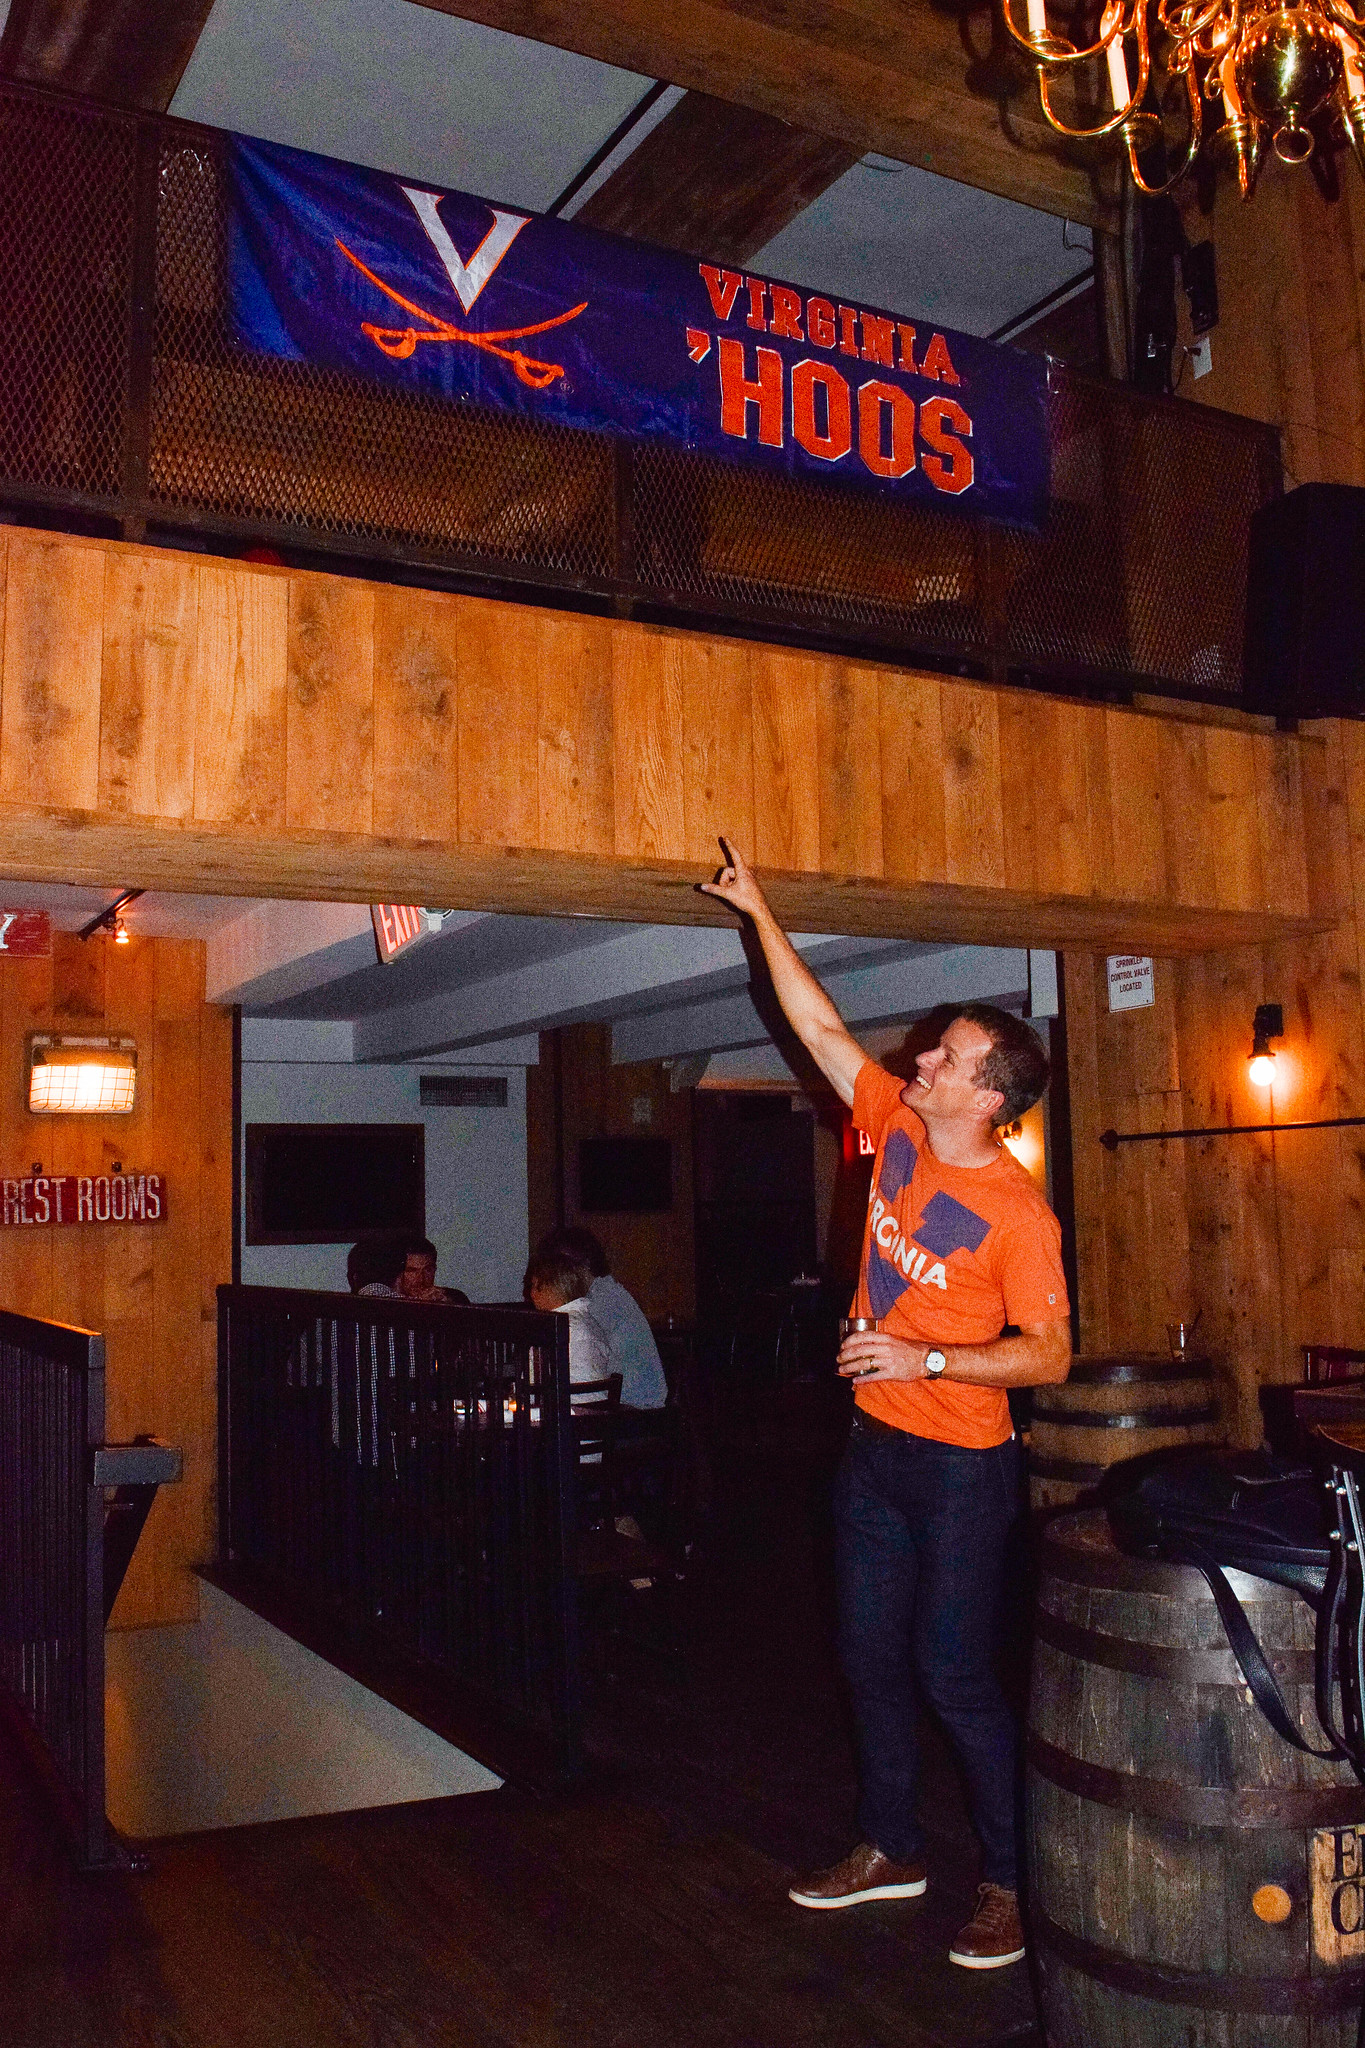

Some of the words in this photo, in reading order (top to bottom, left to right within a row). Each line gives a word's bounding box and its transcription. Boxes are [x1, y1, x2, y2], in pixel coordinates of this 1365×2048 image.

[400, 184, 533, 316] V
[699, 263, 961, 387] VIRGINIA
[1110, 970, 1133, 982] CONTROL
[1133, 966, 1151, 977] VALVE
[1119, 981, 1143, 993] LOCATED
[859, 1129, 875, 1155] EX
[2, 1178, 67, 1225] REST
[77, 1174, 161, 1222] ROOMS
